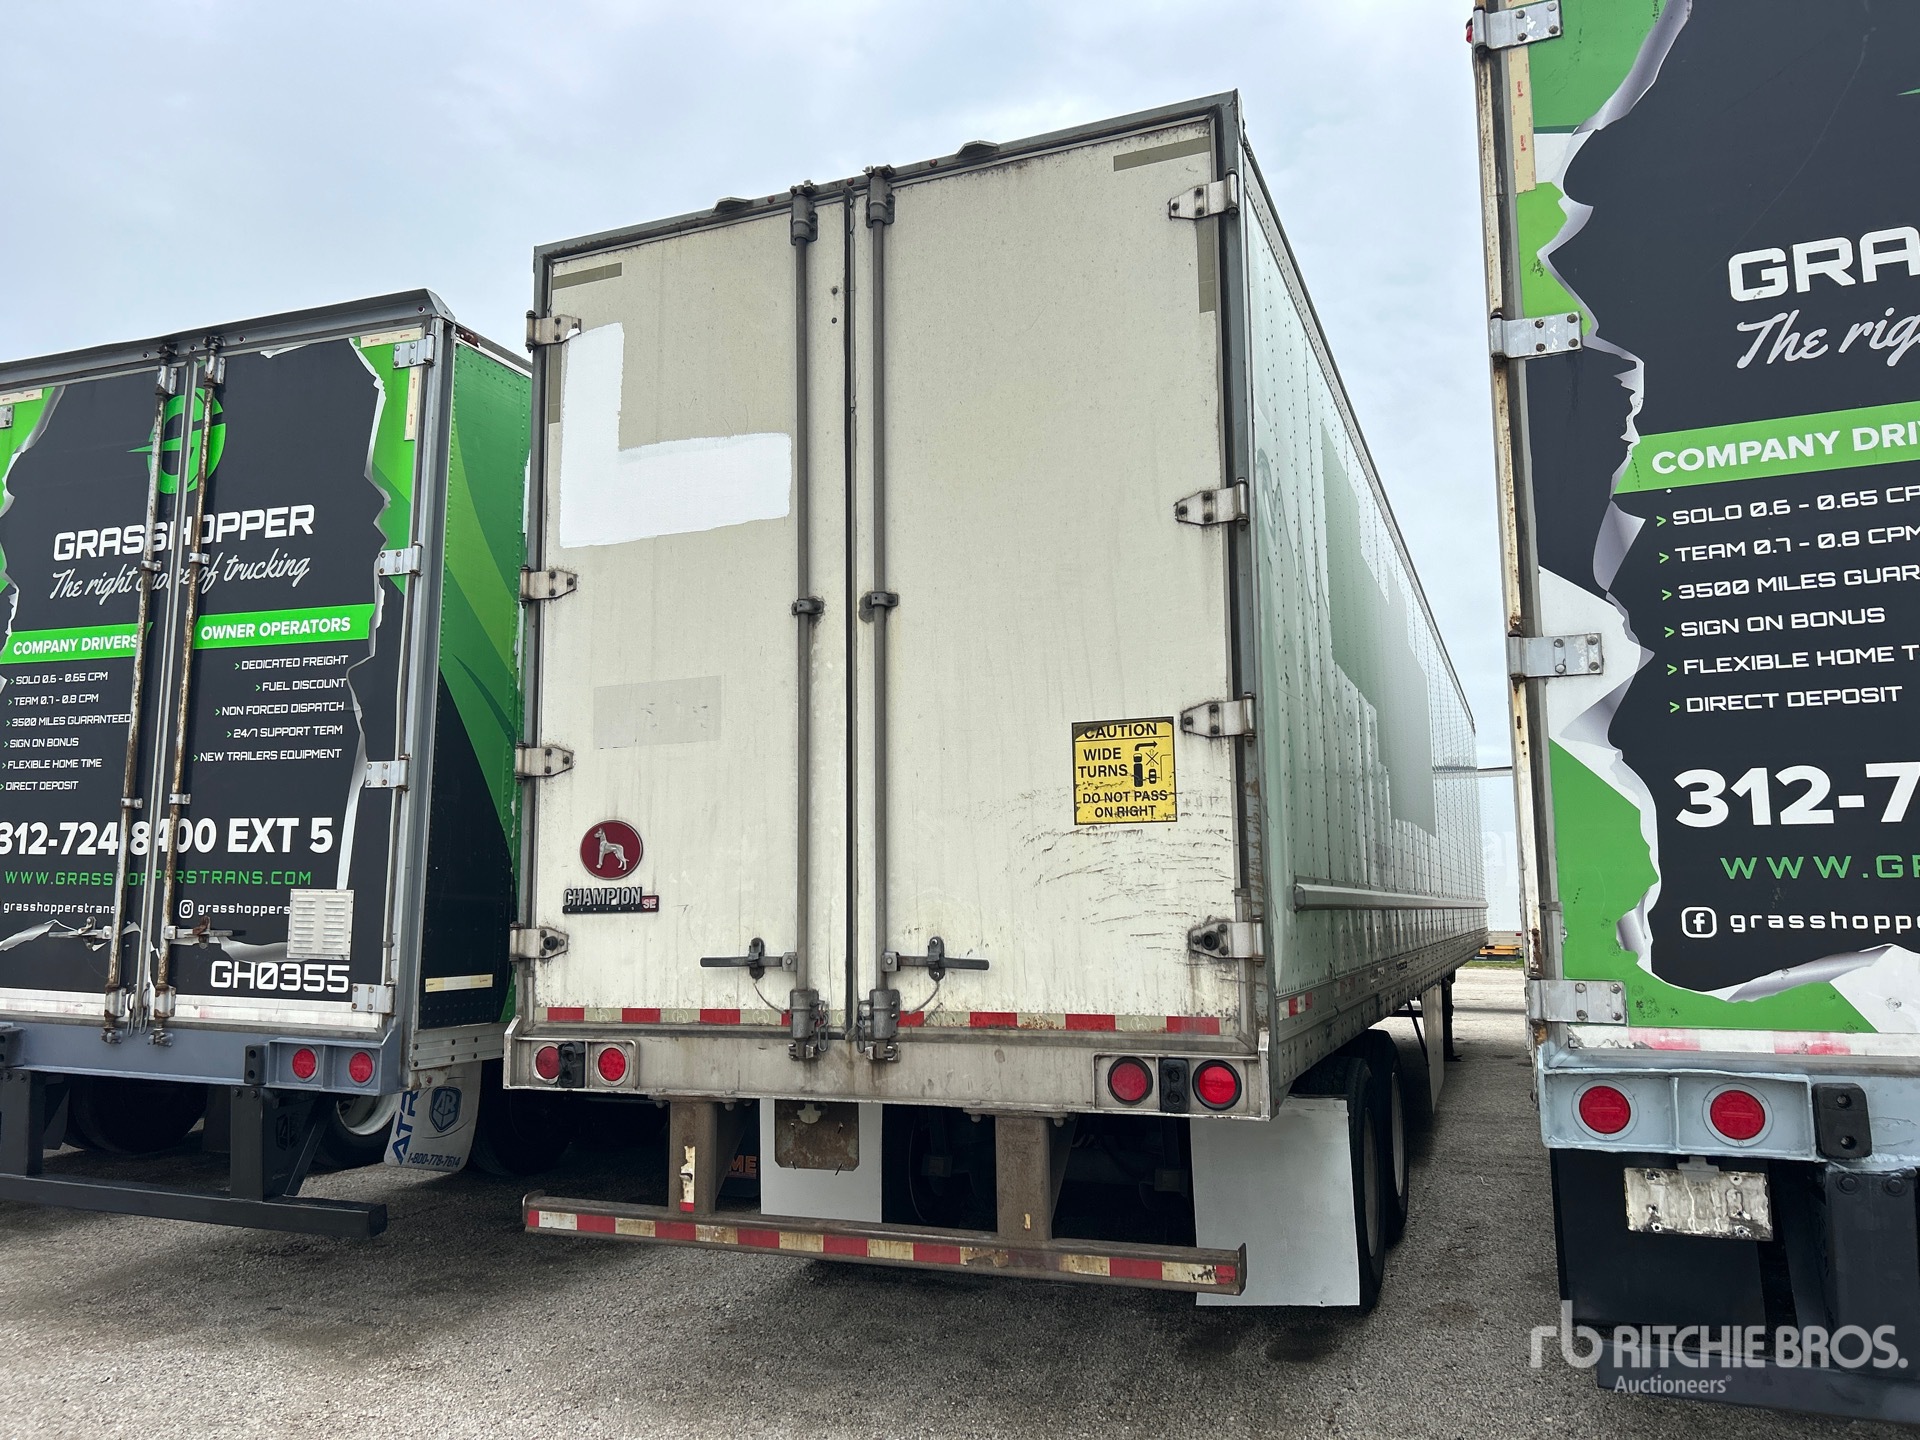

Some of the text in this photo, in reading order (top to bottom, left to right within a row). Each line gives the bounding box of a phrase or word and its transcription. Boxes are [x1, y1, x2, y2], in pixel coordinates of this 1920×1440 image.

[1736, 309, 1828, 369] The
[1652, 421, 1920, 474] COMPANY DRI
[1672, 504, 1742, 525] SOLO
[1750, 499, 1791, 517] 0.6
[1816, 489, 1878, 511] 0.65
[1674, 542, 1746, 563] TEAM
[1753, 537, 1791, 555] 0.7
[1817, 531, 1860, 549] 0.8
[50, 569, 82, 599] The
[84, 563, 139, 606] right
[223, 548, 311, 587] trucking
[1678, 579, 1750, 600] 3500
[1757, 571, 1836, 593] MILES
[201, 617, 351, 640] OWNER OPERATORS
[1681, 607, 1886, 637] SIGN ON BONUS
[13, 633, 138, 655] COMPANY DRIVERS
[241, 655, 348, 670] DEDICATED FREIGHT
[1683, 651, 1810, 675] FLEXIBLE
[1816, 646, 1895, 667] HOME
[15, 675, 40, 685] SOLO
[42, 674, 57, 684] 0.6
[64, 672, 86, 683] 0.65
[87, 671, 108, 681] CPM
[262, 678, 347, 692] FUEL DISCOUNT
[14, 696, 39, 706] TEAM
[61, 694, 77, 704] 0.8
[78, 693, 99, 703] CPM
[1686, 686, 1903, 713] DIRECT DEPOSIT
[221, 701, 345, 716] NON FORCED DISPATCH
[11, 714, 132, 727] 3500 MILES GUARANTEED
[233, 724, 343, 738] 24/7 SUPPORT TEAM
[1084, 722, 1157, 739] CAUTION
[9, 737, 80, 749] SIGN ON BONUS
[200, 748, 342, 762] NEW TRAILERS EQUIPMENT
[1083, 747, 1122, 761] WIDE
[7, 758, 103, 770] FLEXIBLE HOME TIME
[1078, 764, 1128, 778] TURNS
[5, 780, 79, 791] DIRECT DEPOSIT
[1082, 789, 1168, 804] DO NOT PASS
[1094, 805, 1157, 818] ON RIGHT
[0, 818, 334, 856] 312-7248400 EXT 5
[1720, 855, 1920, 880] WWW.G
[562, 887, 642, 906] CHAMPION
[3, 902, 116, 915] grasshopperstrans
[197, 903, 291, 917] grasshoppers
[1730, 911, 1920, 935] grasshopp
[406, 1152, 461, 1168] 1-800-778-7614
